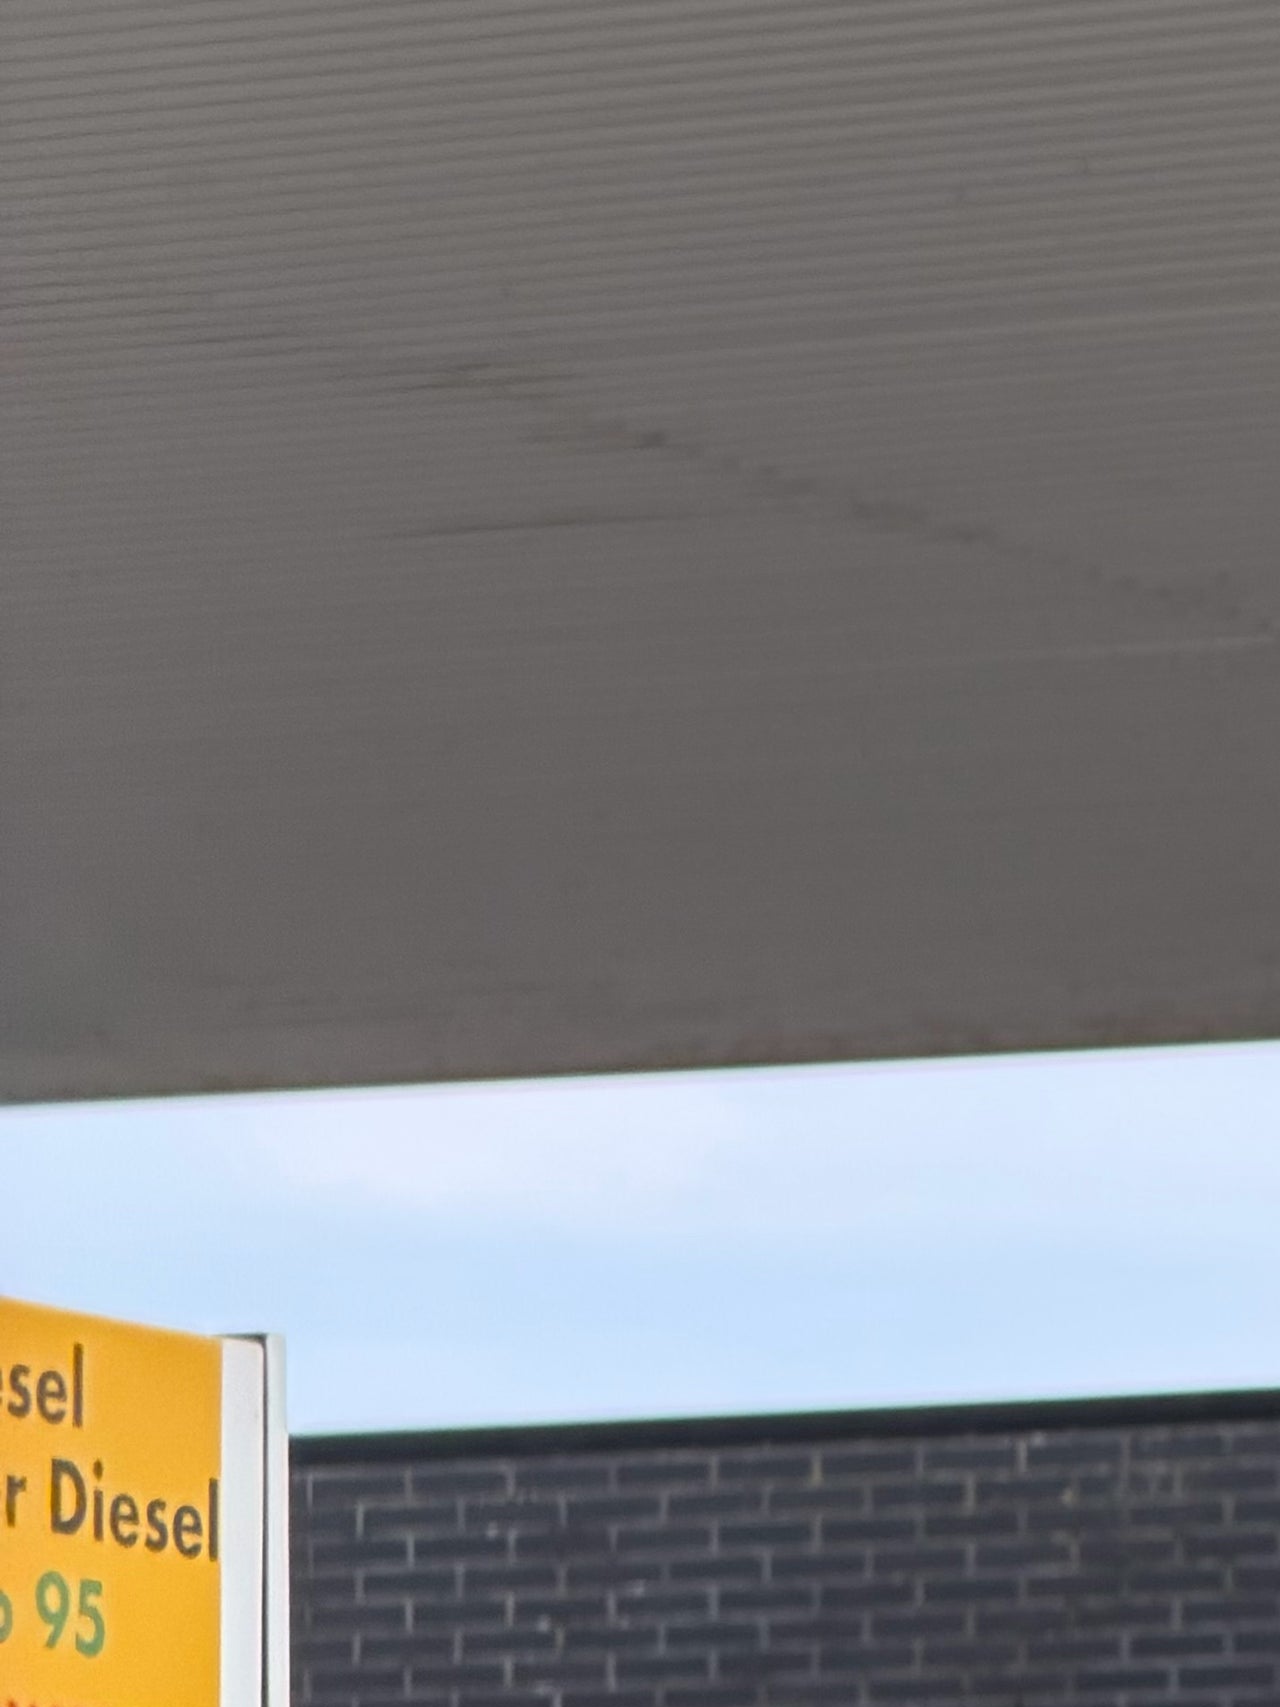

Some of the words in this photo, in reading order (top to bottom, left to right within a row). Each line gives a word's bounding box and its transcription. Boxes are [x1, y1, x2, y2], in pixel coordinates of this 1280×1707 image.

[0, 1342, 84, 1428] sel
[50, 1457, 219, 1562] Diesel
[35, 1569, 106, 1659] 95
